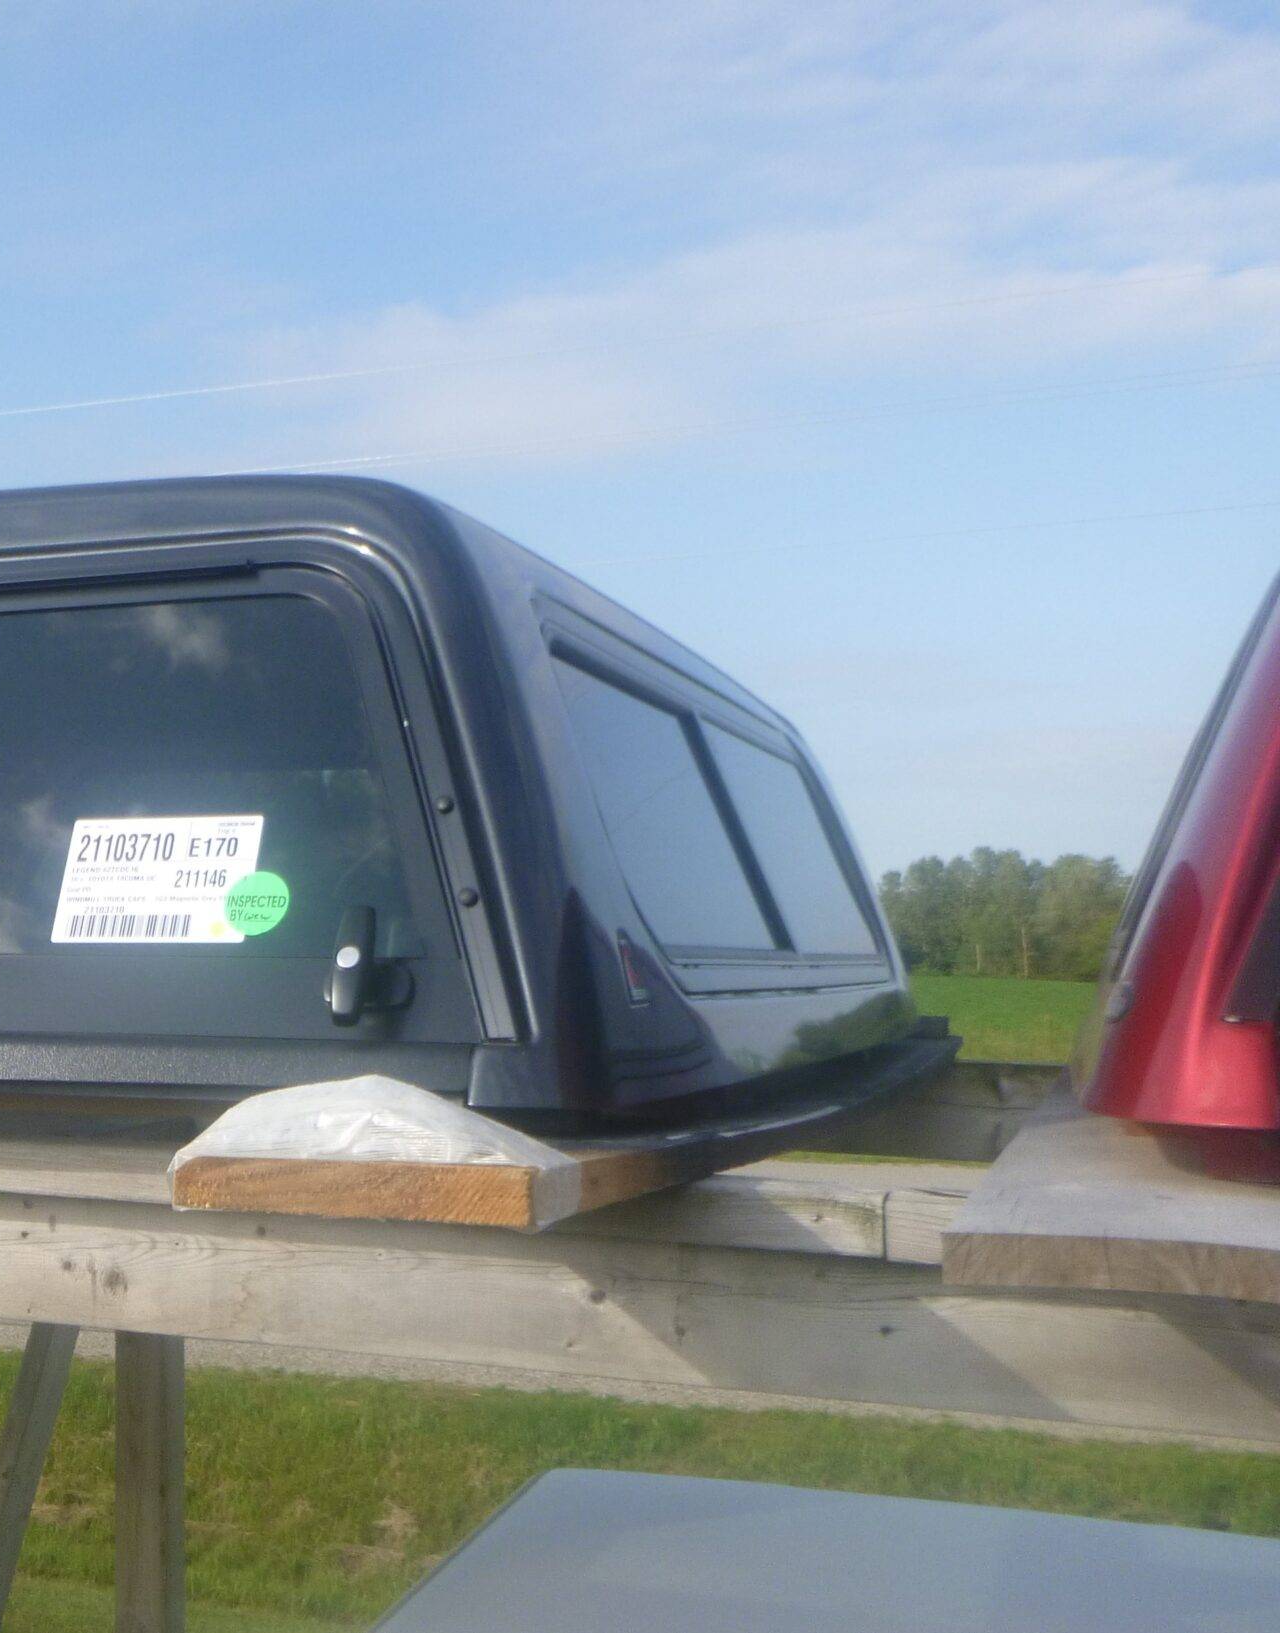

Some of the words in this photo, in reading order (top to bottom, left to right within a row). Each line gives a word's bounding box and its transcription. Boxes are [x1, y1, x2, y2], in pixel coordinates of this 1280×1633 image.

[76, 832, 175, 862] 21103710
[188, 837, 238, 858] E170
[173, 869, 228, 888] 211146
[226, 895, 287, 908] INSPECTED
[230, 908, 244, 921] BY
